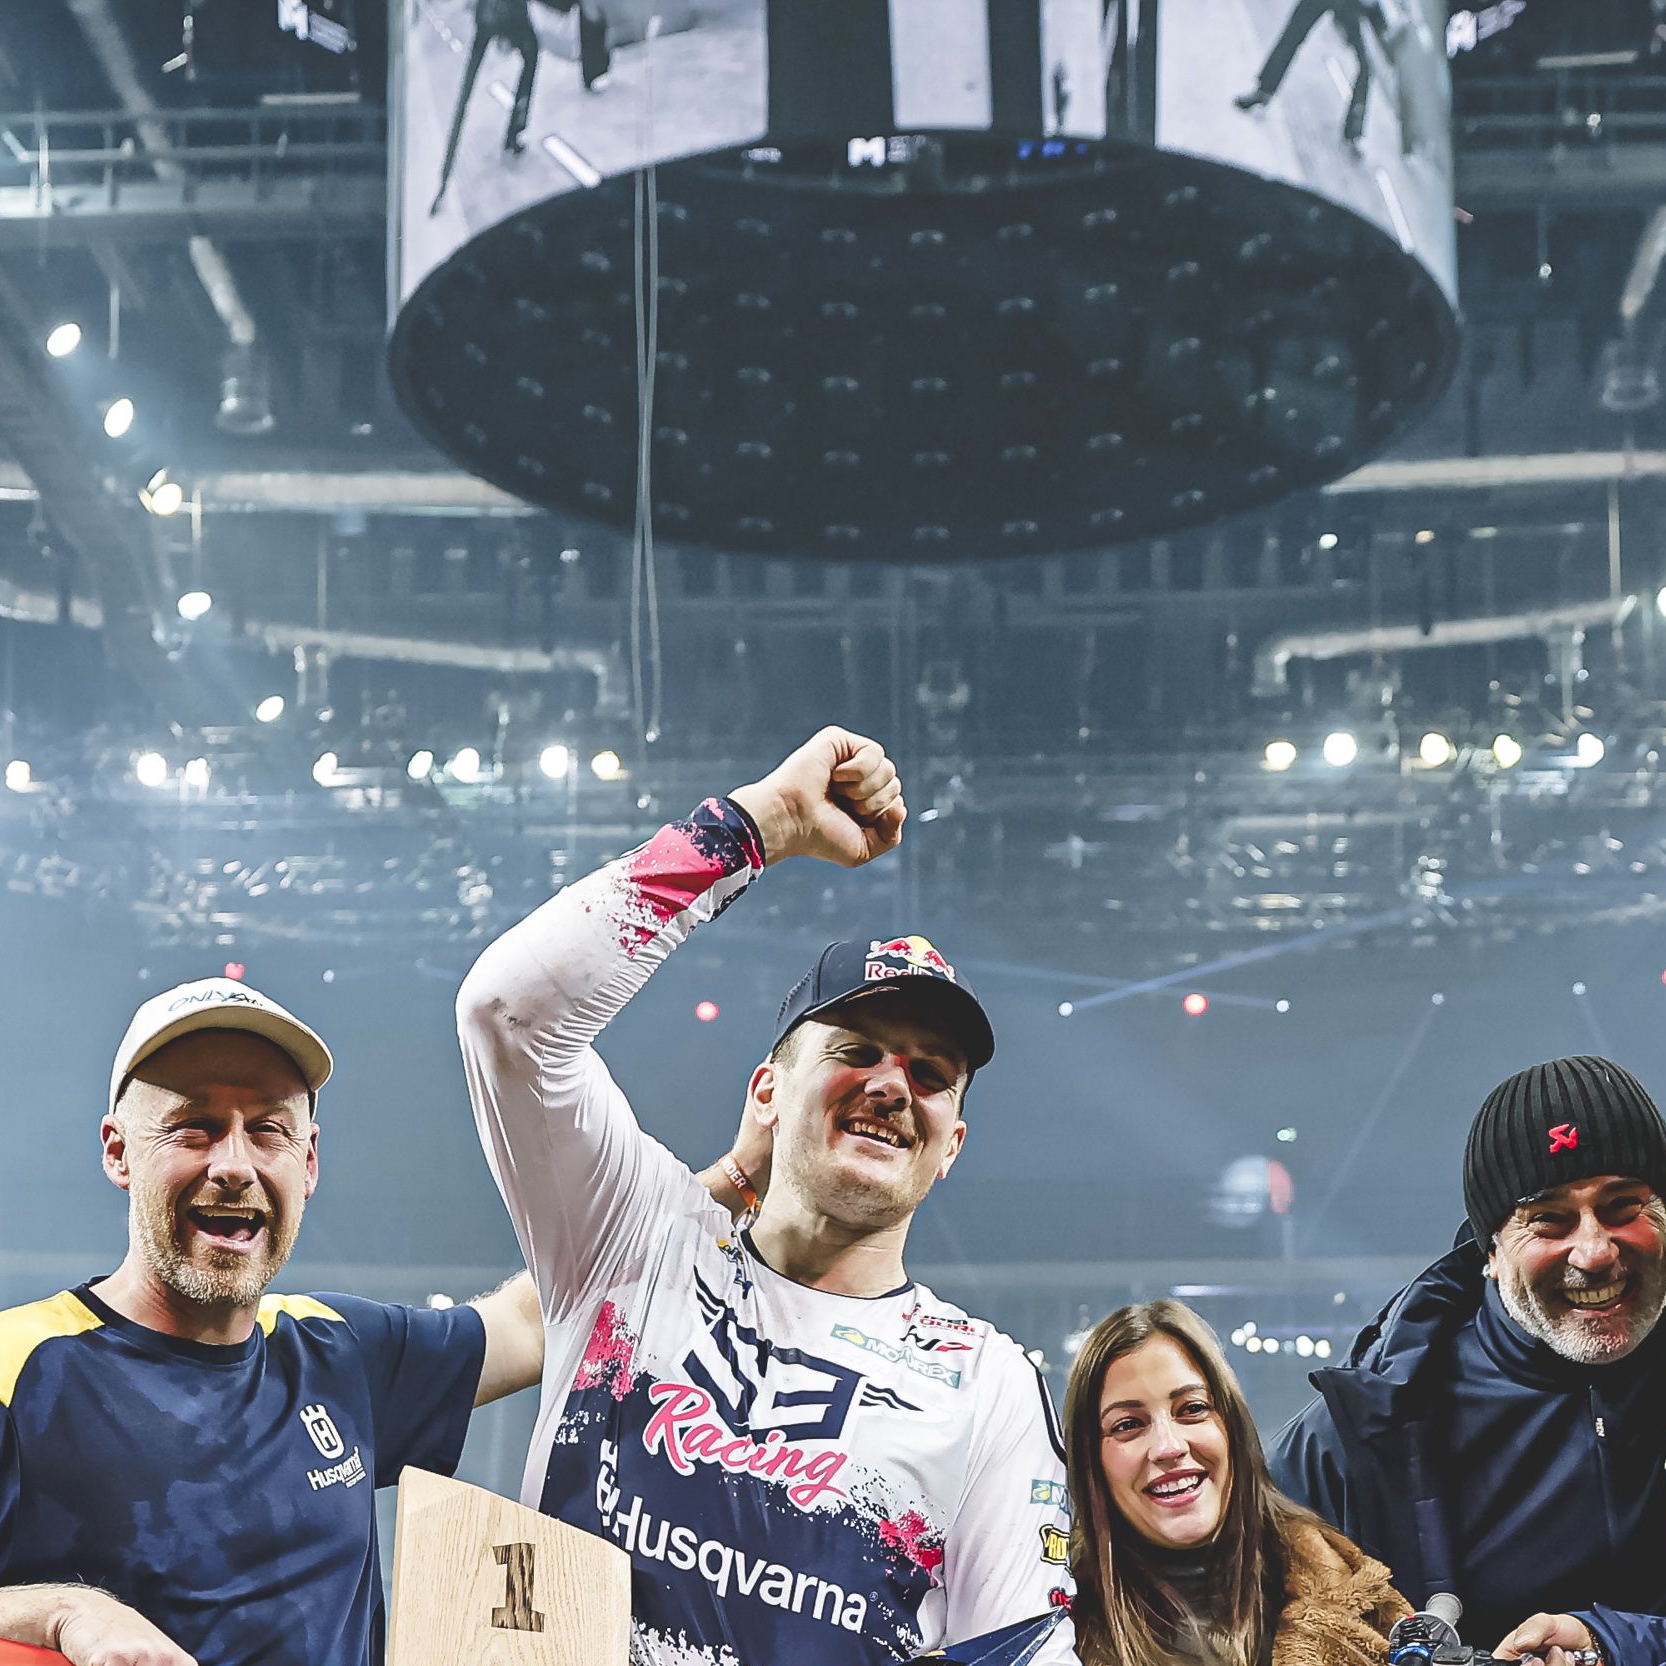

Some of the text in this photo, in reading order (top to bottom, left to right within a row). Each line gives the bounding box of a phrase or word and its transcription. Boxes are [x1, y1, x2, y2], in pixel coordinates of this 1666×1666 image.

[643, 1382, 849, 1507] Racing
[491, 1542, 545, 1633] 1
[611, 1495, 868, 1634] Husqvarna
